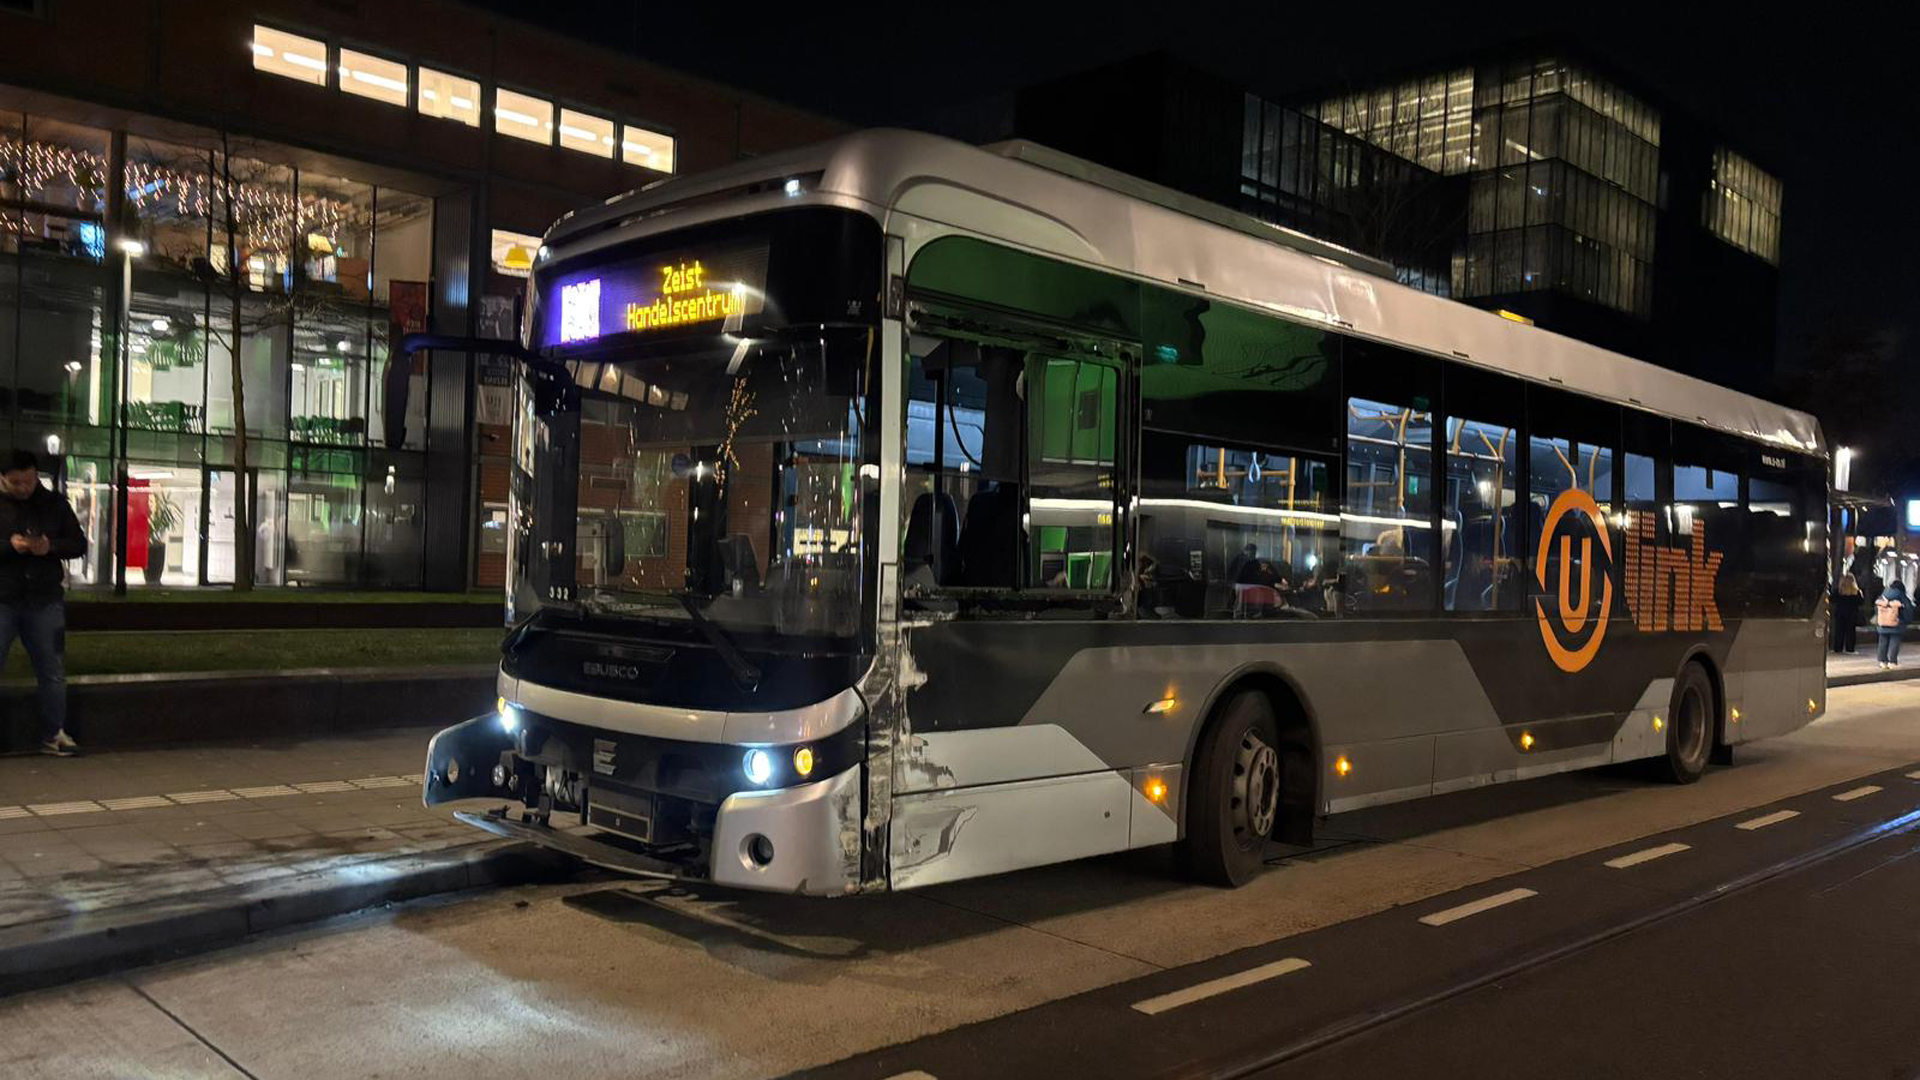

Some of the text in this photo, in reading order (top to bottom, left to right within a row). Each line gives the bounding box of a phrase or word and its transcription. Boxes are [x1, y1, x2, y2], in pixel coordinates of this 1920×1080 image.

[663, 260, 702, 294] Zeist
[627, 287, 746, 330] Handelscentrum
[1625, 510, 1724, 631] link
[549, 585, 569, 601] 332
[583, 661, 639, 680] EBUSCO
